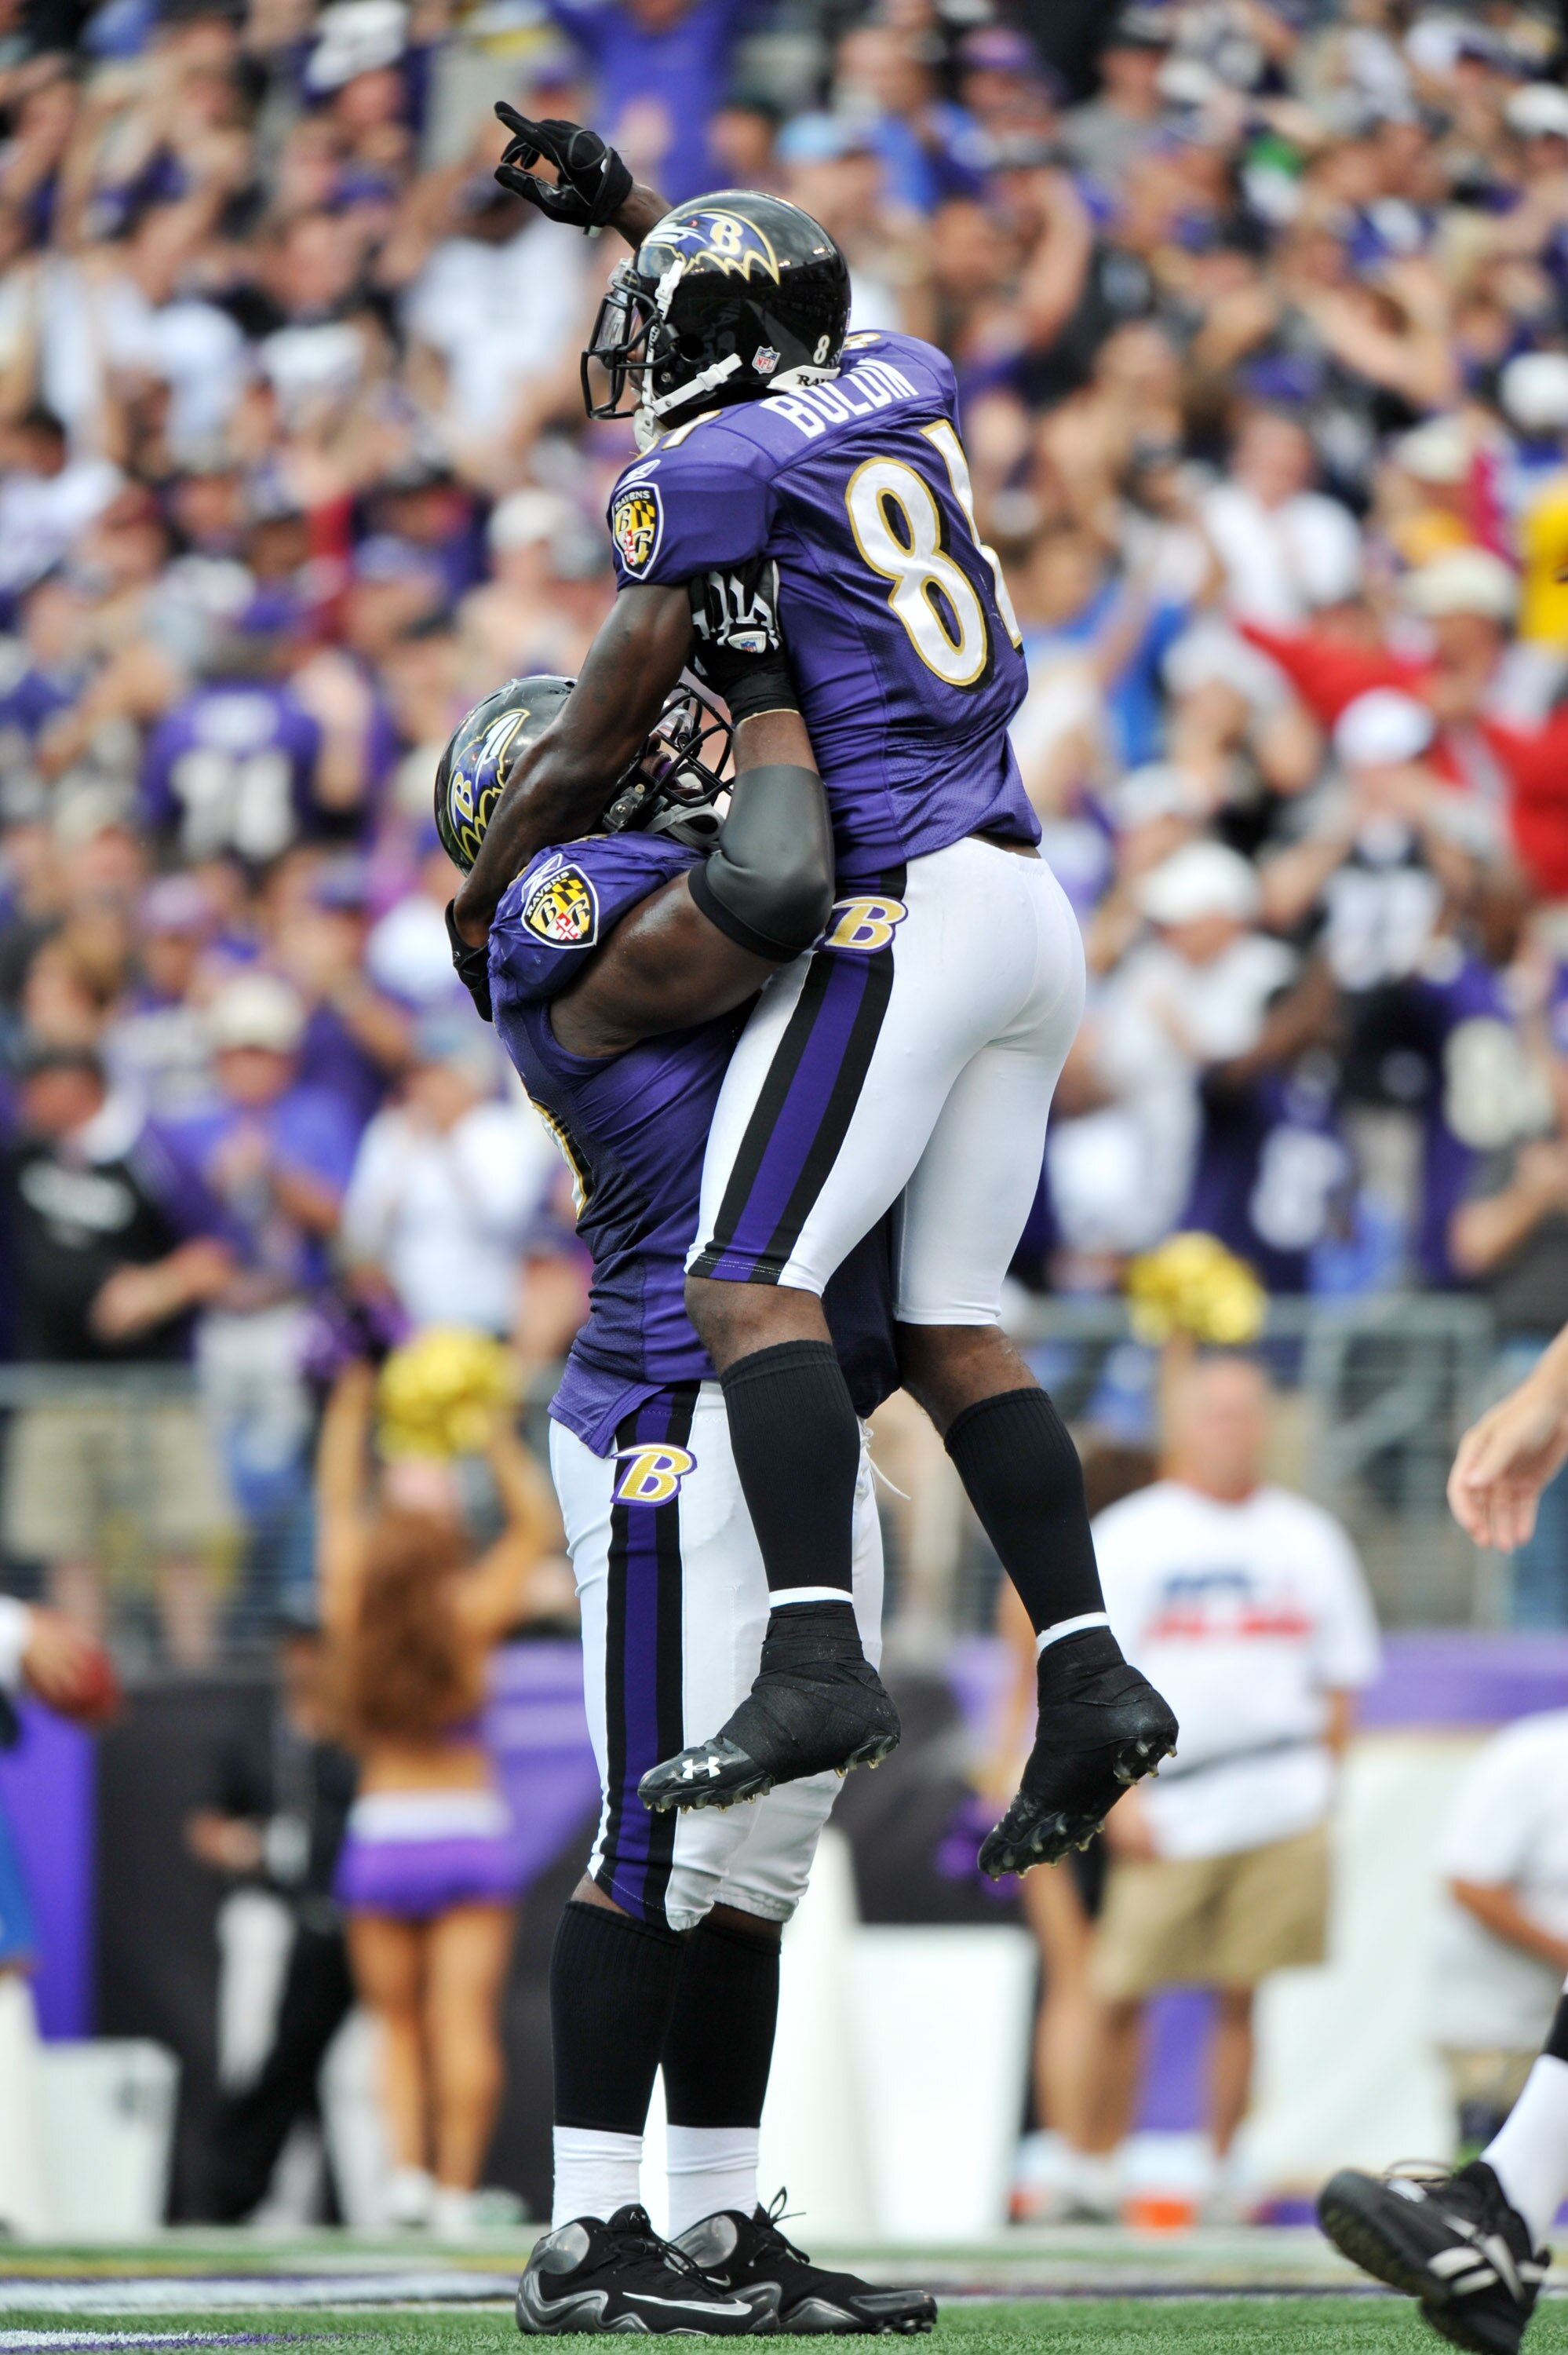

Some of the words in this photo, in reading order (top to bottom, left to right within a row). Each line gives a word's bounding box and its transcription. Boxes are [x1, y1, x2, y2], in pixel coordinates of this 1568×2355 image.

[699, 213, 744, 255] B
[756, 356, 774, 371] NFL
[759, 357, 920, 439] BOLDIN
[614, 490, 651, 512] RAVENS
[450, 771, 474, 829] B
[526, 871, 570, 917] RAVENS
[536, 897, 556, 928] B
[823, 895, 907, 952] B
[611, 1443, 695, 1505] B
